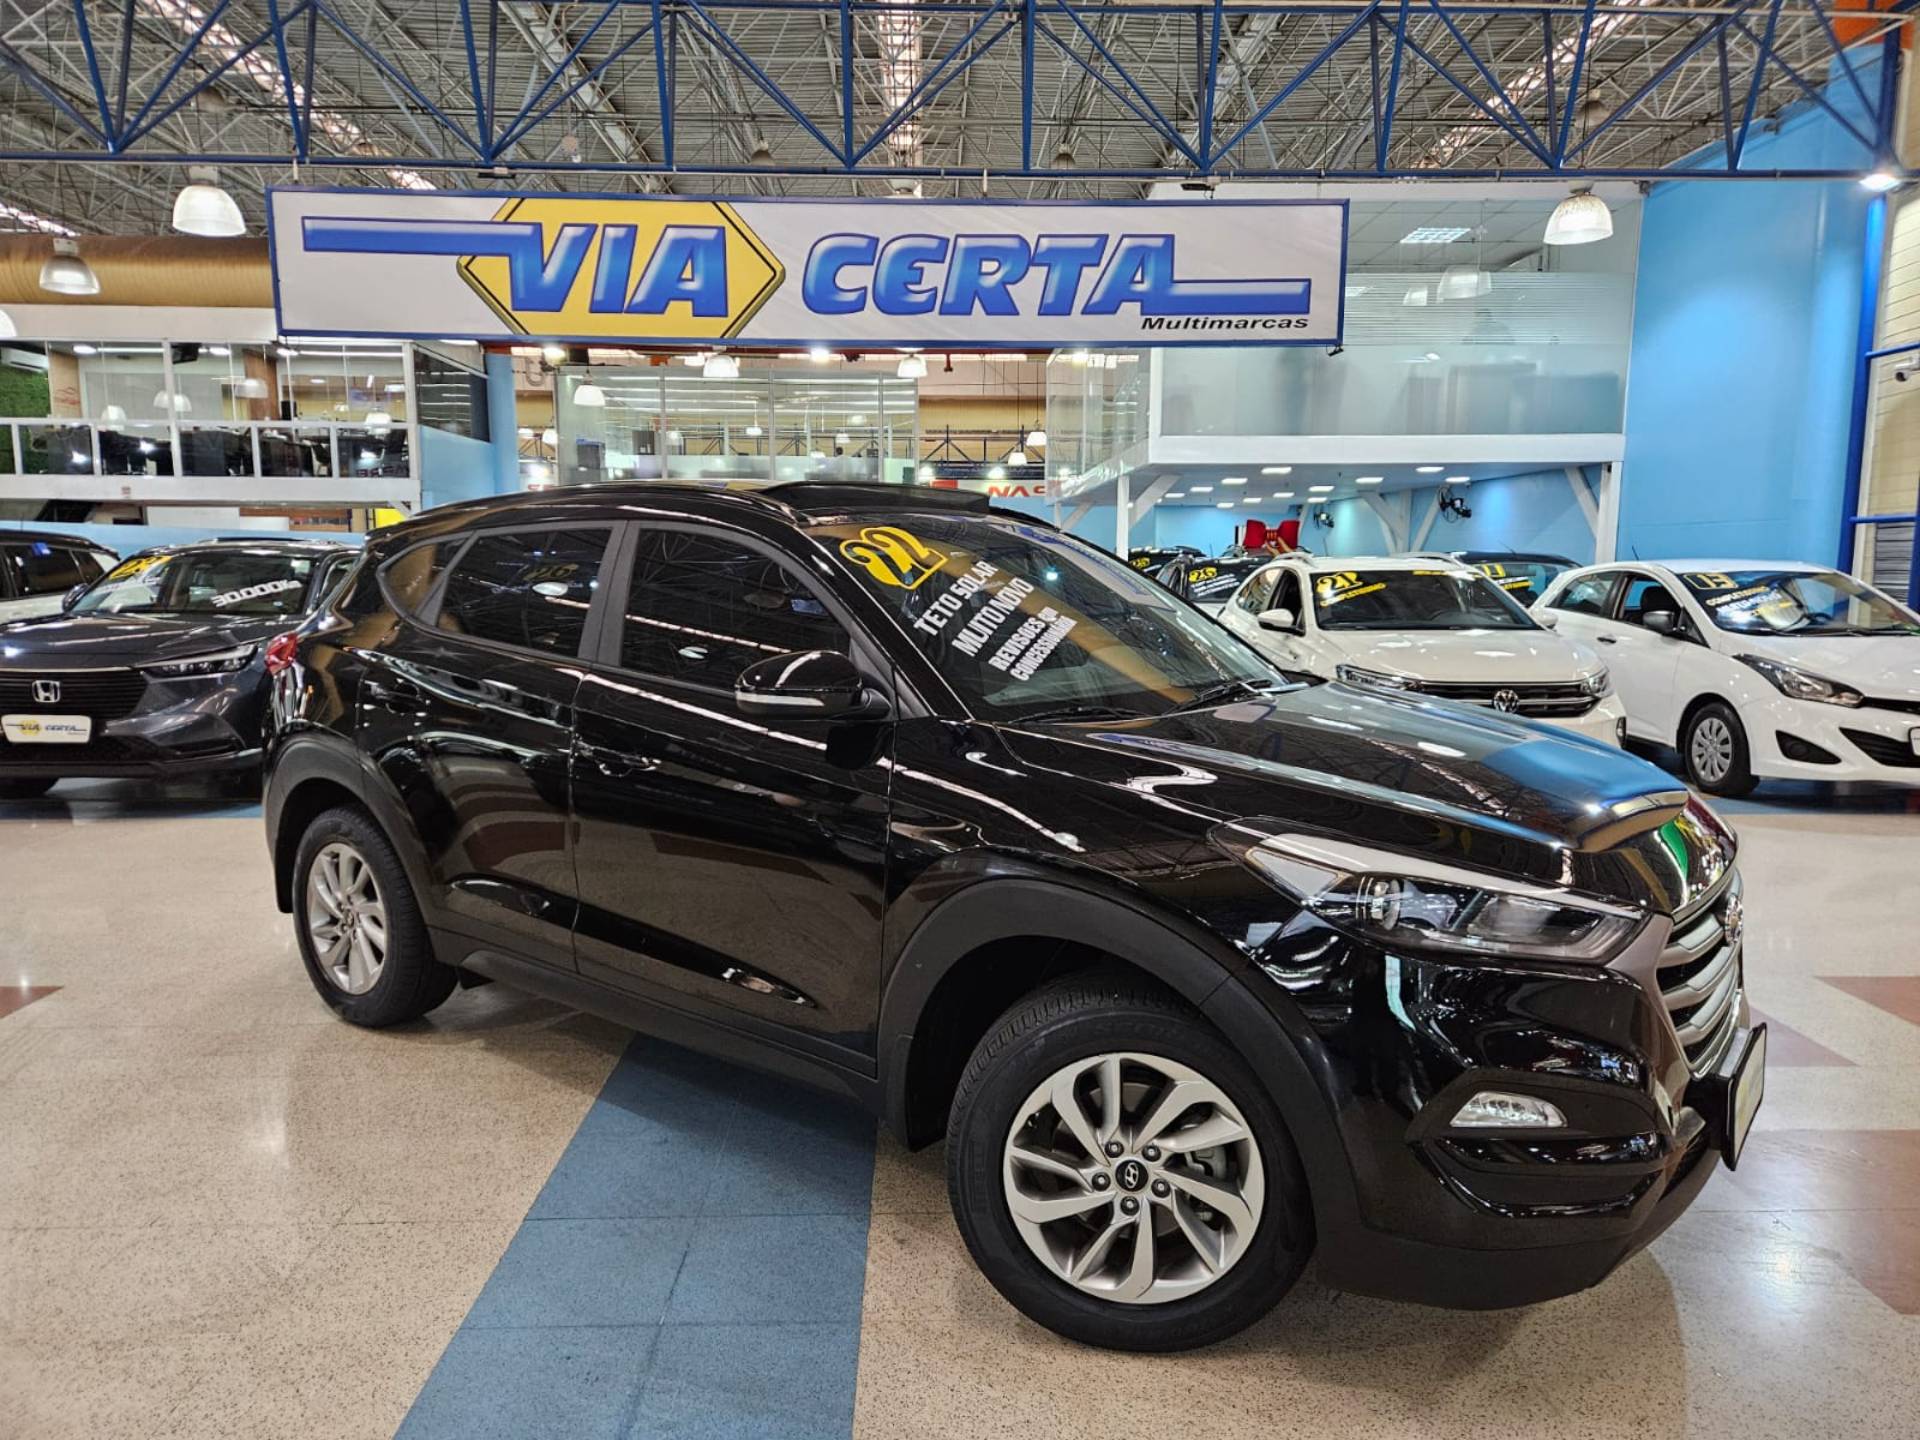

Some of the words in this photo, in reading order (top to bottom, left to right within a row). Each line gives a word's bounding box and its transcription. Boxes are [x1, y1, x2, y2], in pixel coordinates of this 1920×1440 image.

[500, 221, 729, 317] VIA
[802, 232, 1174, 315] CERTA
[1141, 314, 1310, 331] Multimarcas
[839, 526, 948, 590] 22
[913, 593, 963, 636] TETO
[949, 560, 999, 599] SOLAR
[951, 605, 1006, 657] MUITO
[989, 577, 1035, 615] NOVO
